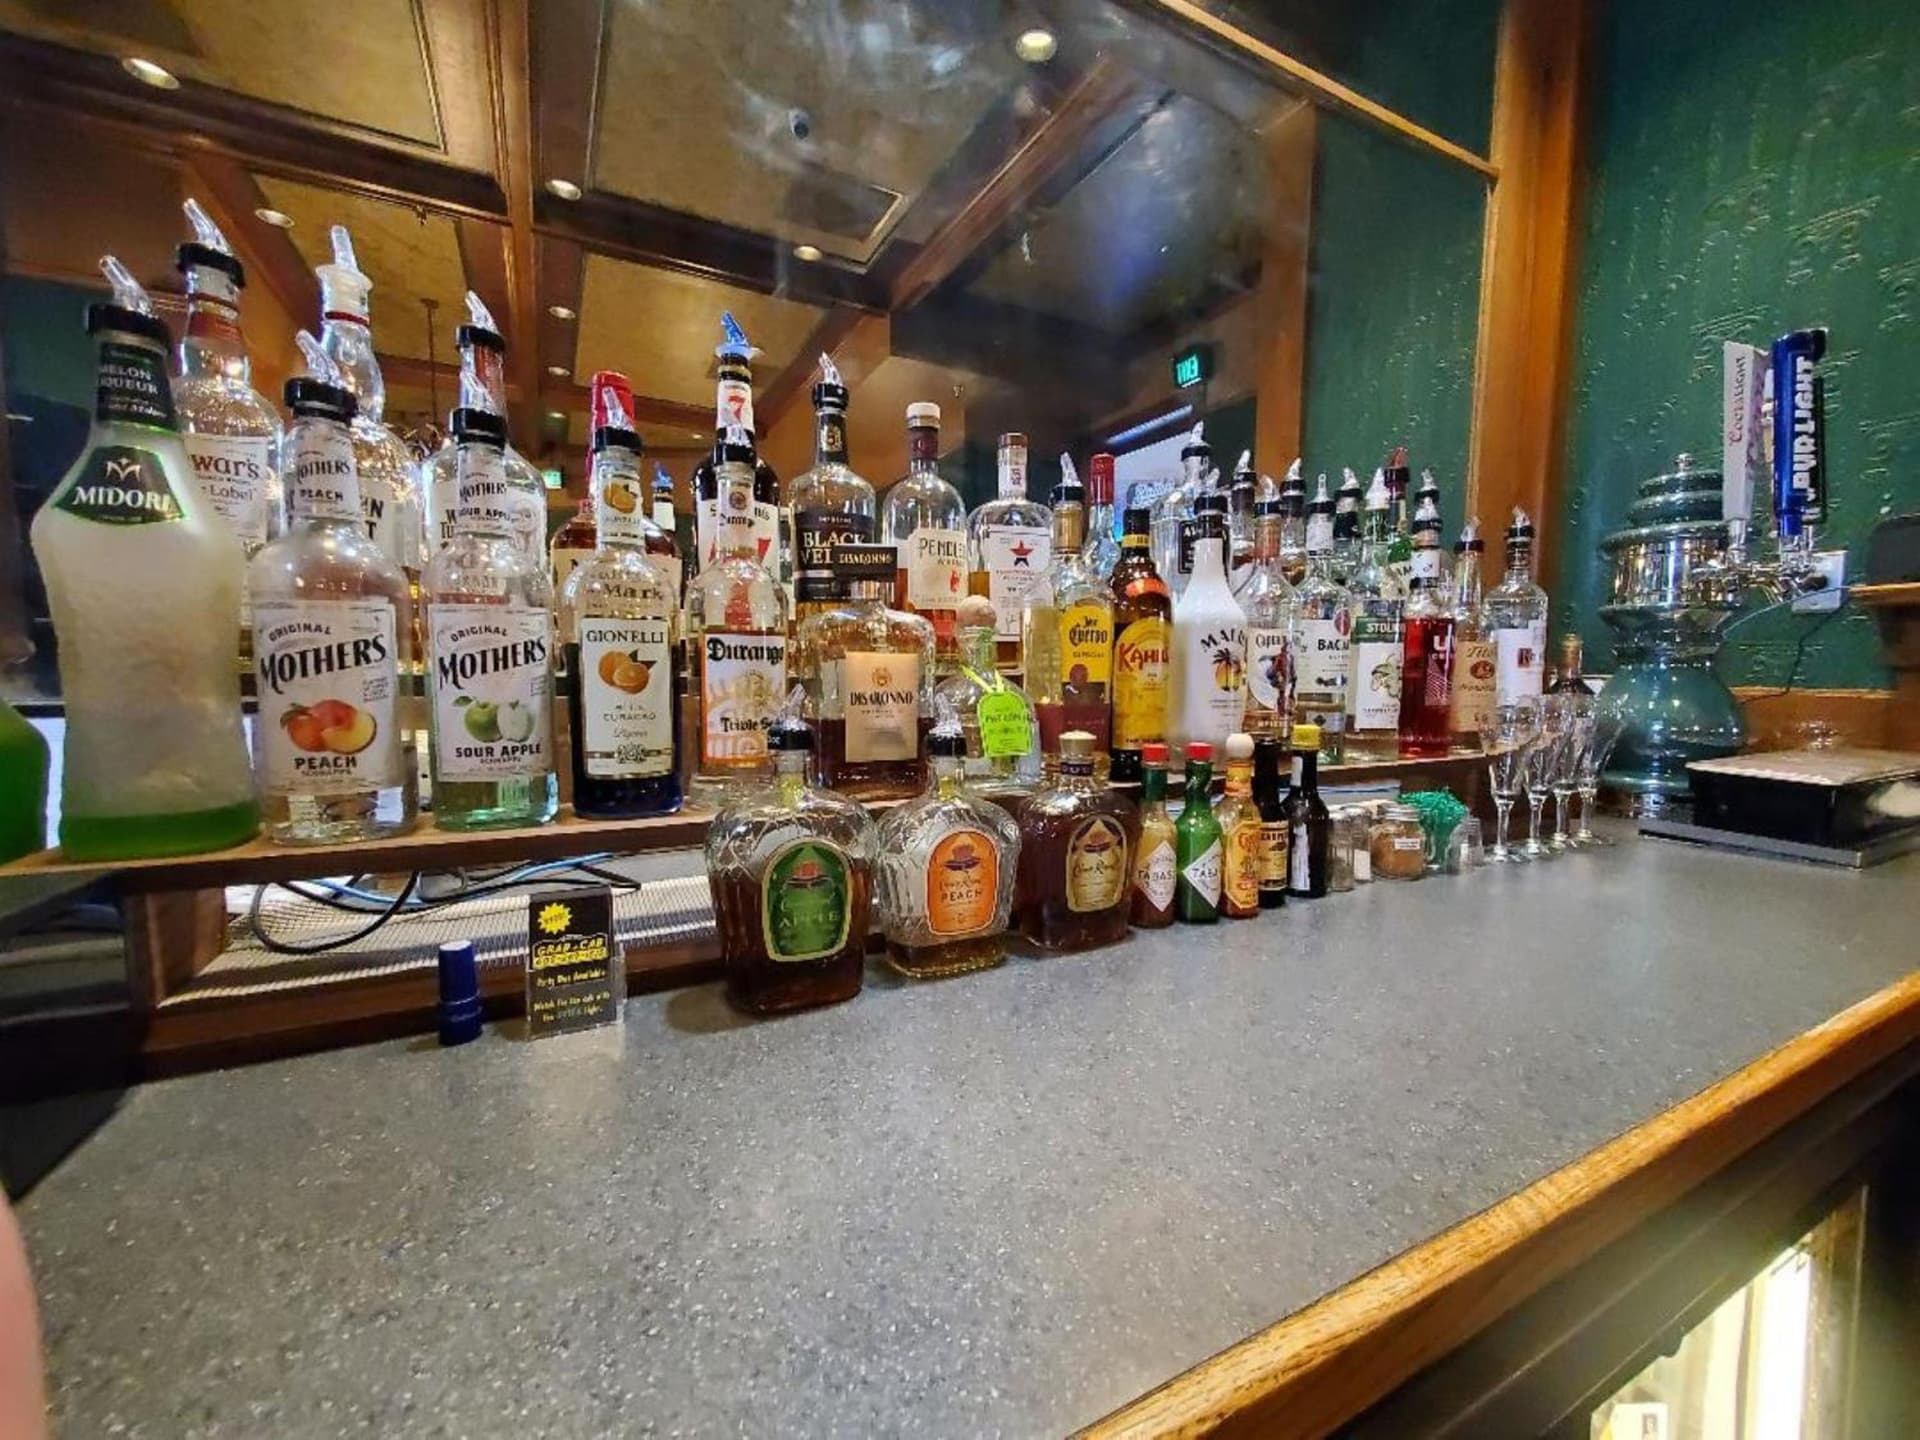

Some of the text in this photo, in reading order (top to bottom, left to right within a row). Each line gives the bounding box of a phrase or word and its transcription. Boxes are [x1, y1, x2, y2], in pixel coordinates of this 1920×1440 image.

[1793, 356, 1817, 490] BUD LIGHT
[72, 486, 170, 511] MIDORI
[803, 531, 865, 548] BLACK
[267, 622, 332, 643] ORIGINAL
[450, 624, 508, 643] ORIGINAL
[585, 630, 665, 644] GIONELLI
[261, 633, 387, 695] MOTHERS
[438, 635, 547, 691] MOTHERS
[720, 716, 758, 733] Triple
[456, 742, 542, 758] SOUR APPLE
[294, 755, 358, 770] PEACH
[940, 888, 982, 903] PEACH
